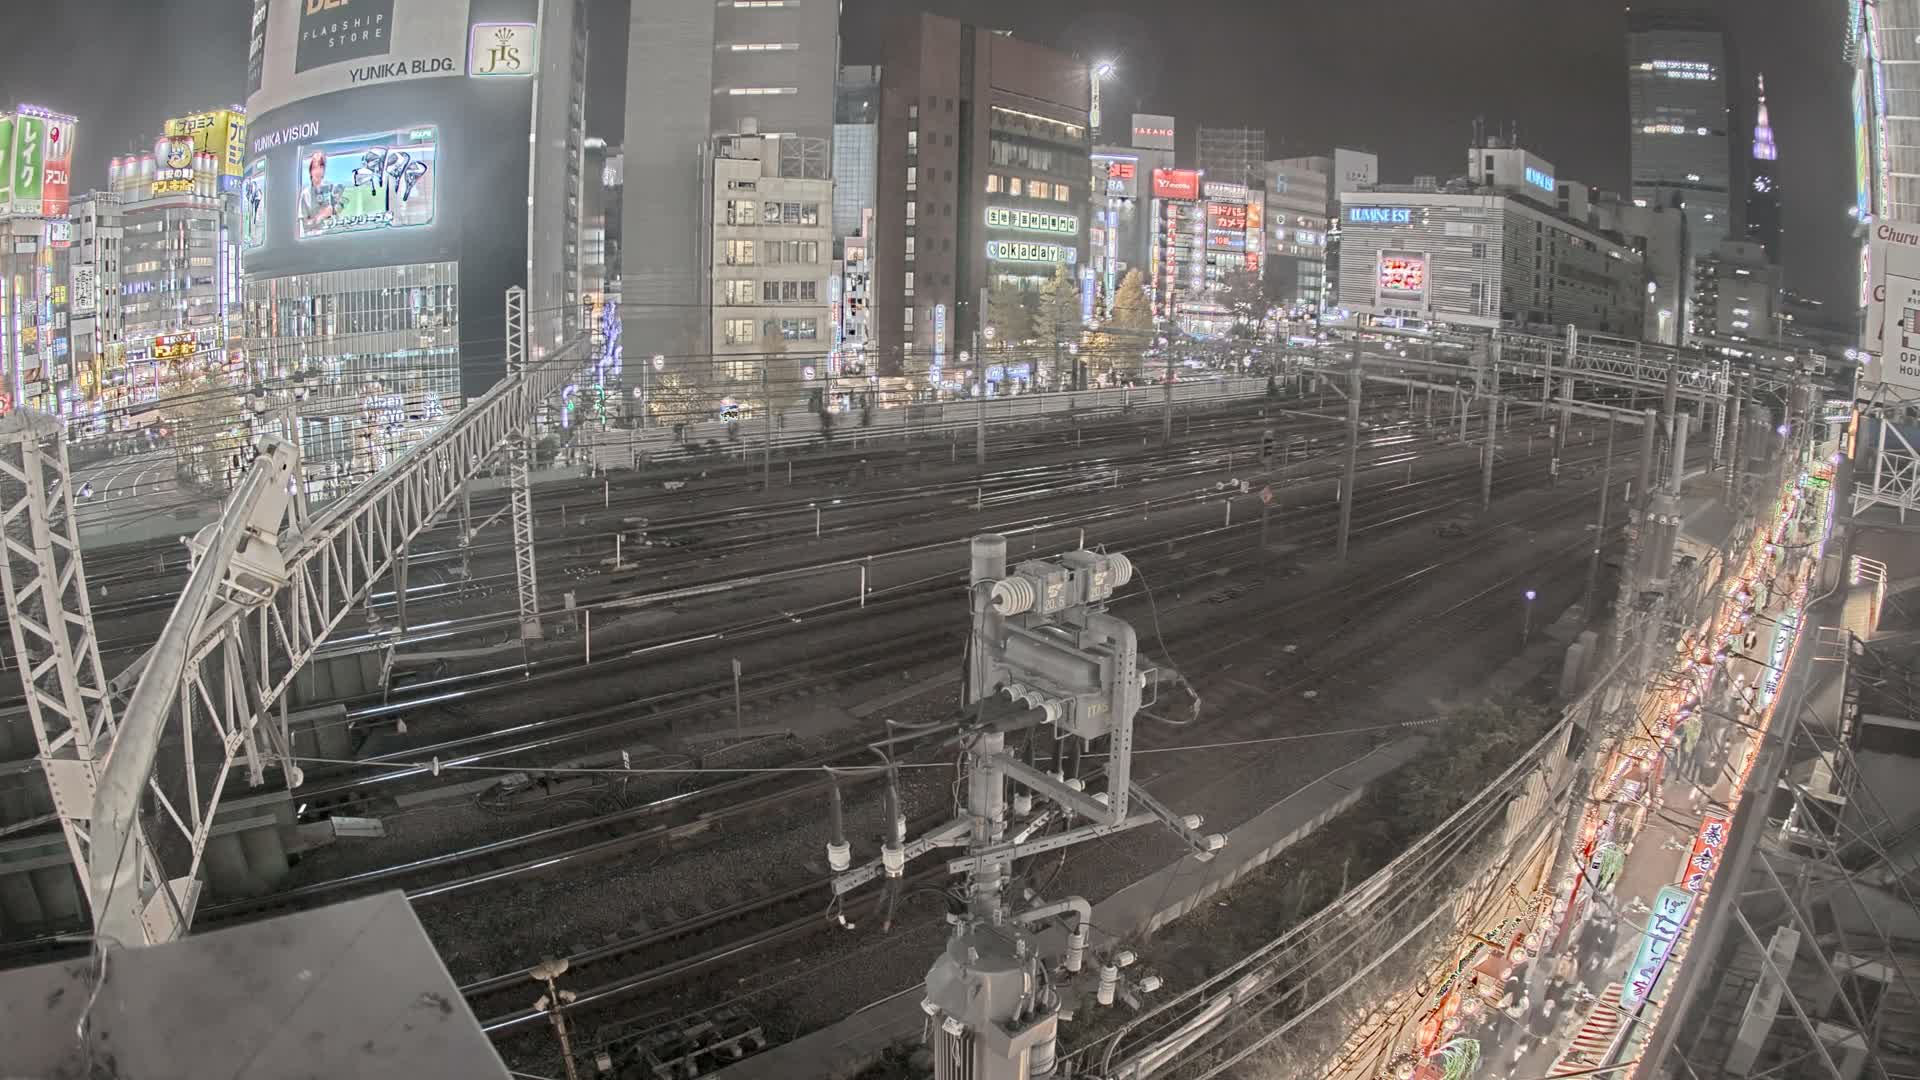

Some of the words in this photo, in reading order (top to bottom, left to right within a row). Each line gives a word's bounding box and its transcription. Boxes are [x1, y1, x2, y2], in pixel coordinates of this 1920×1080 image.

[303, 14, 383, 40] FLAGSHIP
[328, 28, 382, 47] STORE
[350, 62, 408, 83] YUNIKA
[411, 57, 456, 74] BLDG.
[177, 117, 214, 132] プロミス
[1134, 127, 1174, 137] TAKANO
[254, 131, 281, 153] YUNIKA
[283, 121, 320, 143] VISION
[21, 121, 37, 188] レイク
[45, 169, 68, 184] アコム
[1208, 205, 1246, 217] ヨドバシ
[1392, 208, 1412, 222] EST
[1217, 217, 1246, 228] カメラ
[1877, 224, 1919, 246] Churu
[1000, 243, 1065, 260] okadaya
